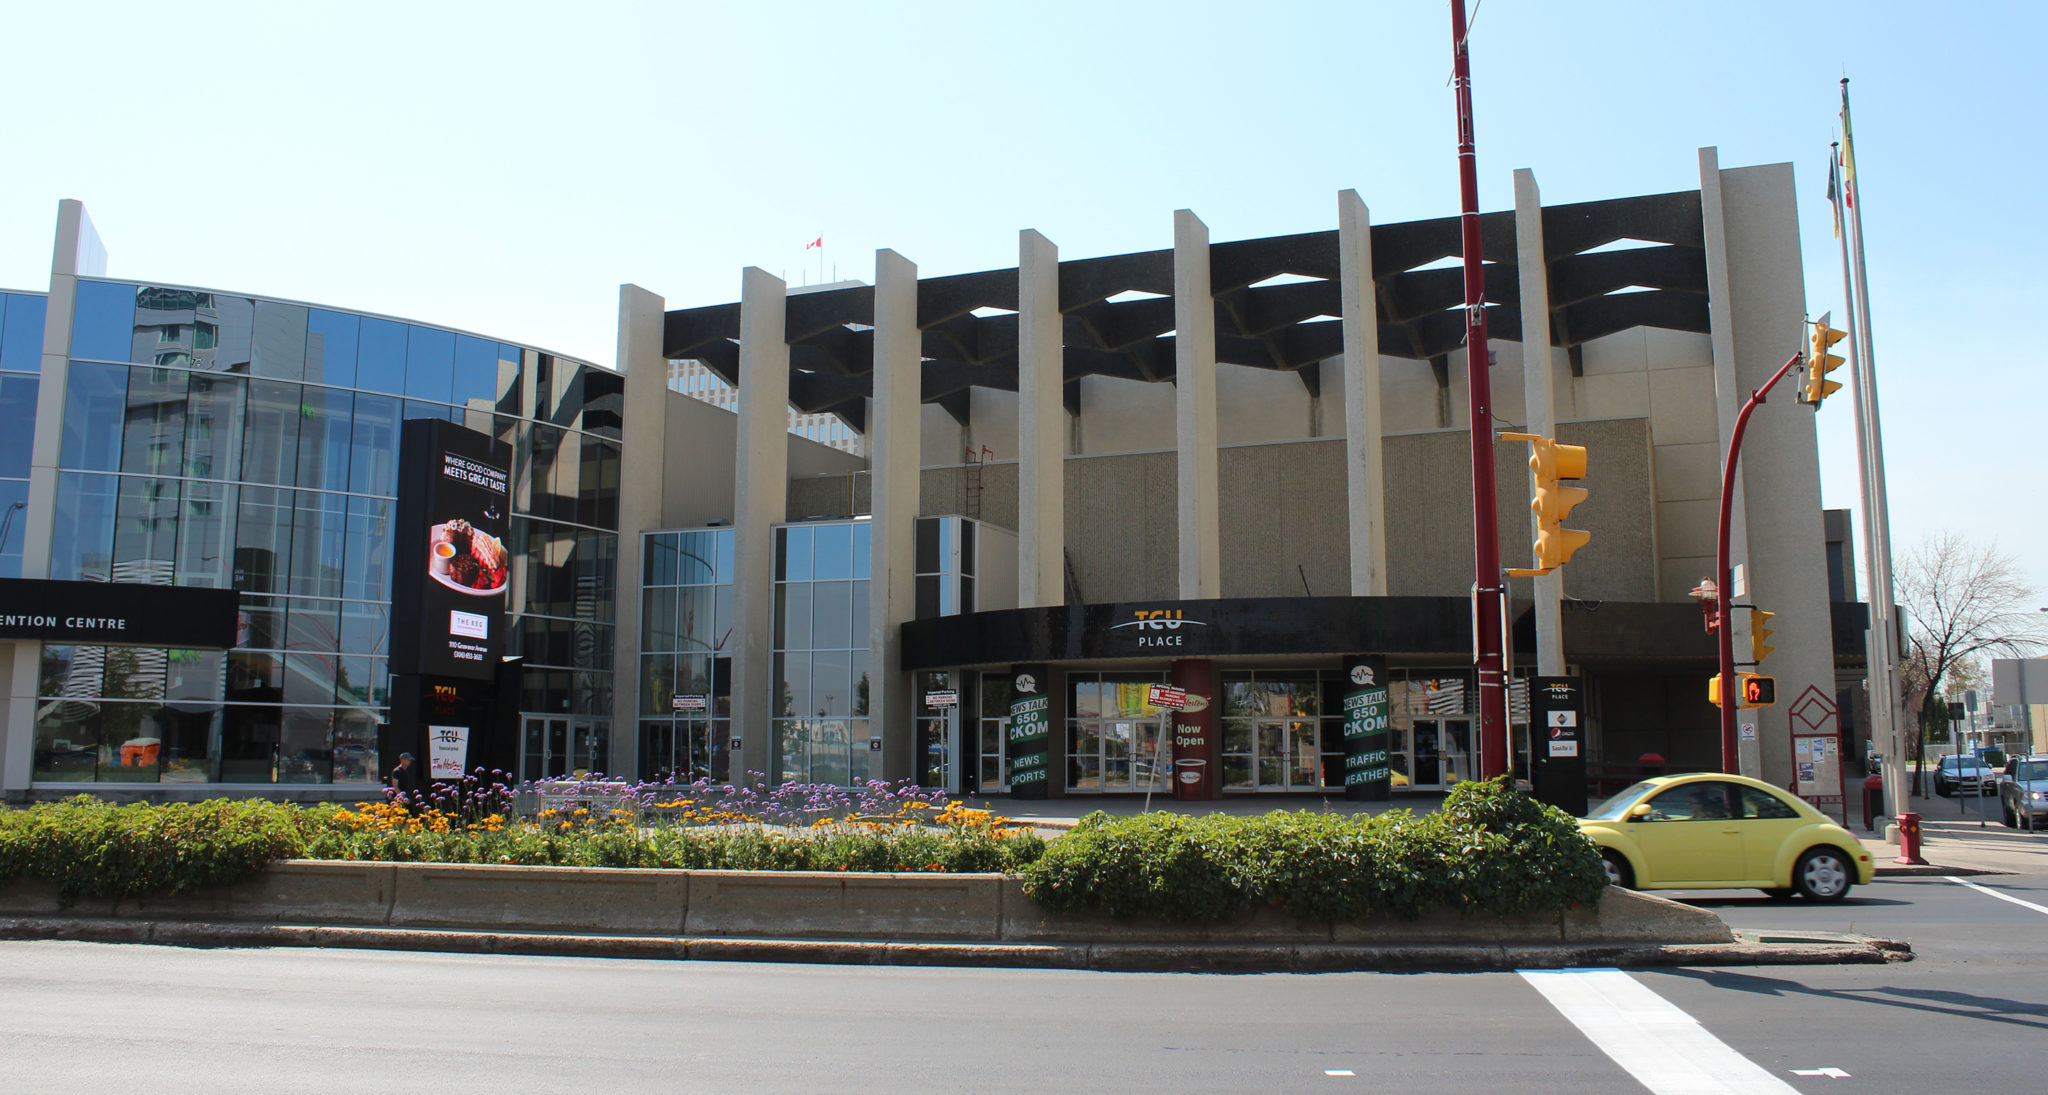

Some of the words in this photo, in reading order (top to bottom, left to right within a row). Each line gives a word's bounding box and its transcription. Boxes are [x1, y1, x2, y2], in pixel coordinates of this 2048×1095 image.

[444, 455, 466, 469] WHERE
[466, 462, 483, 474] GOOD
[483, 467, 507, 482] COMPANY
[443, 465, 468, 480] MEETS
[468, 473, 489, 487] GREAT
[489, 478, 506, 493] TASTE
[65, 617, 126, 630] CENTRE
[457, 617, 470, 625] THE
[1134, 609, 1183, 630] TCU
[1138, 636, 1182, 647] PLACE
[434, 685, 456, 703] TCU
[1550, 683, 1569, 692] TCU
[1366, 690, 1387, 704] TALK
[1011, 702, 1027, 715] EWS
[1028, 697, 1048, 711] TALK
[1353, 706, 1377, 719] 650
[1016, 712, 1038, 724] 650
[1010, 721, 1048, 740] CKOM
[1177, 724, 1201, 734] Now
[1344, 715, 1388, 736] CKOM
[440, 730, 458, 743] TCU
[1176, 736, 1205, 748] Open
[1014, 755, 1040, 769] NEWS
[1346, 751, 1386, 768] TRAFFIC
[1011, 770, 1046, 785] SPORTS
